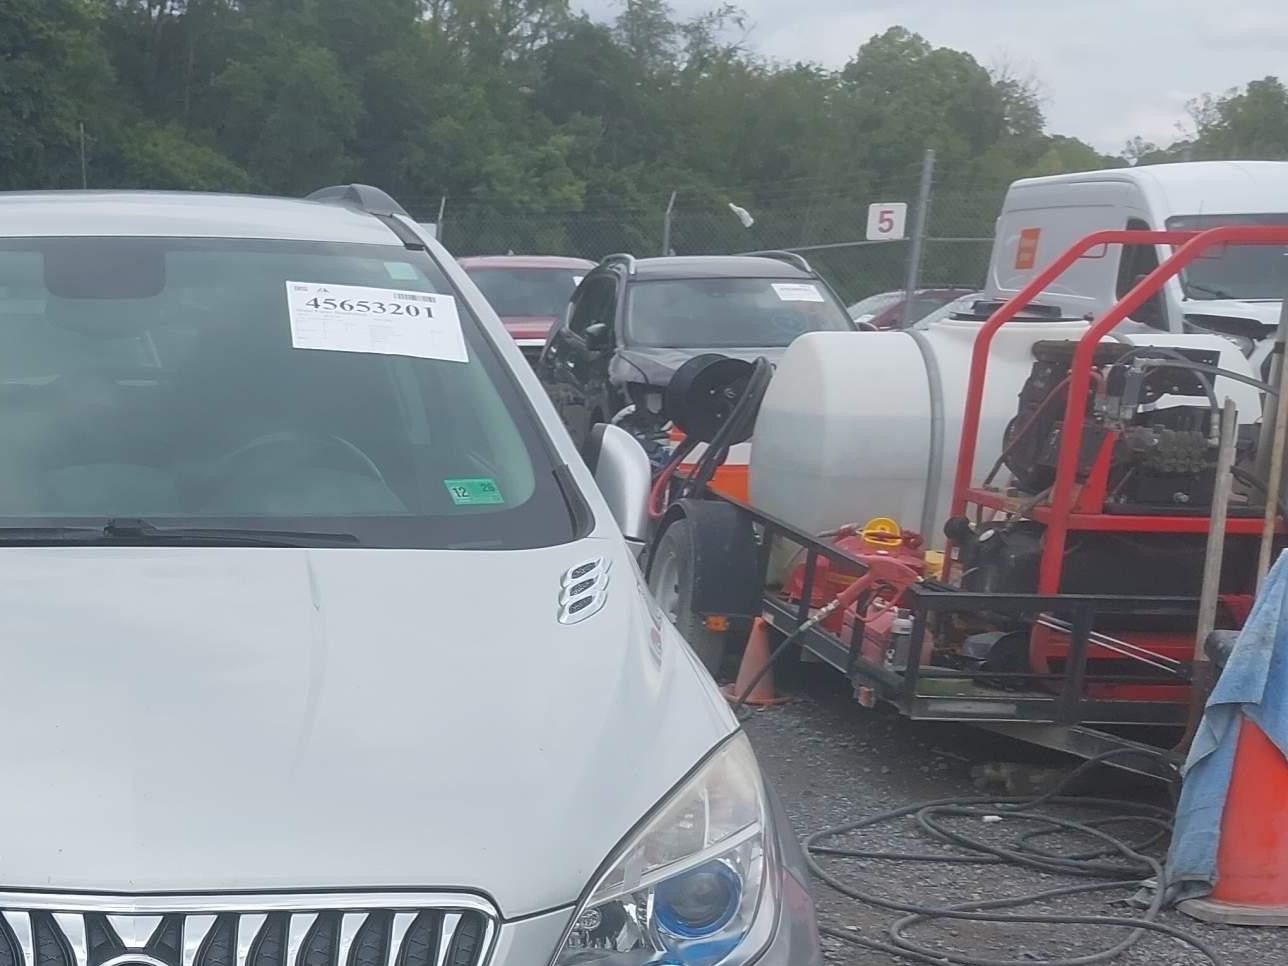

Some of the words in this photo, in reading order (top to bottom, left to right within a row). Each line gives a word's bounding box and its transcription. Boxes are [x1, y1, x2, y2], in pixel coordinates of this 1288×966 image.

[877, 209, 895, 234] 5
[305, 296, 435, 319] 45653201
[452, 486, 470, 498] 12
